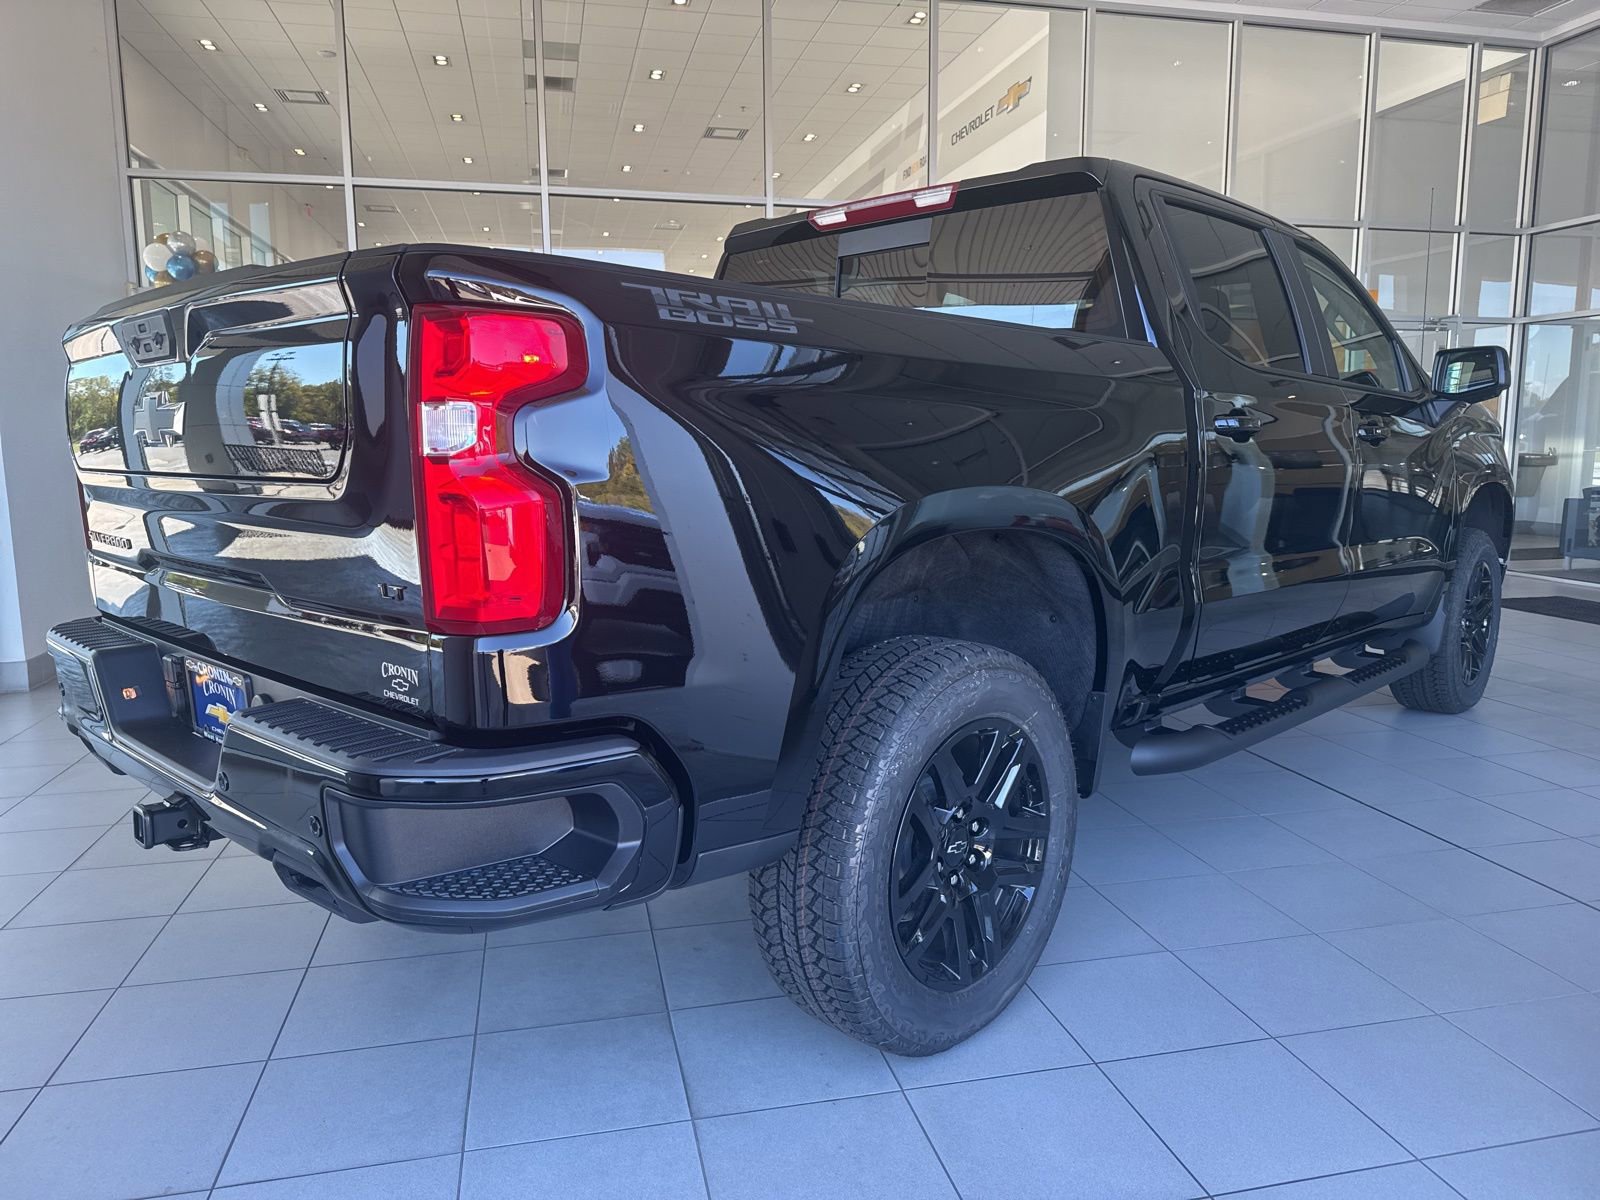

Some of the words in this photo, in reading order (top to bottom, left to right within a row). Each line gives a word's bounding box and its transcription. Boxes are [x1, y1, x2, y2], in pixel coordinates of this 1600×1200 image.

[951, 105, 996, 146] CHEVROLET
[621, 281, 814, 323] TRAIL
[656, 305, 799, 334] BOSS
[377, 582, 408, 601] LT
[381, 661, 419, 687] CRONIN
[202, 680, 237, 710] CRONIN
[383, 689, 419, 706] CHEVROLET
